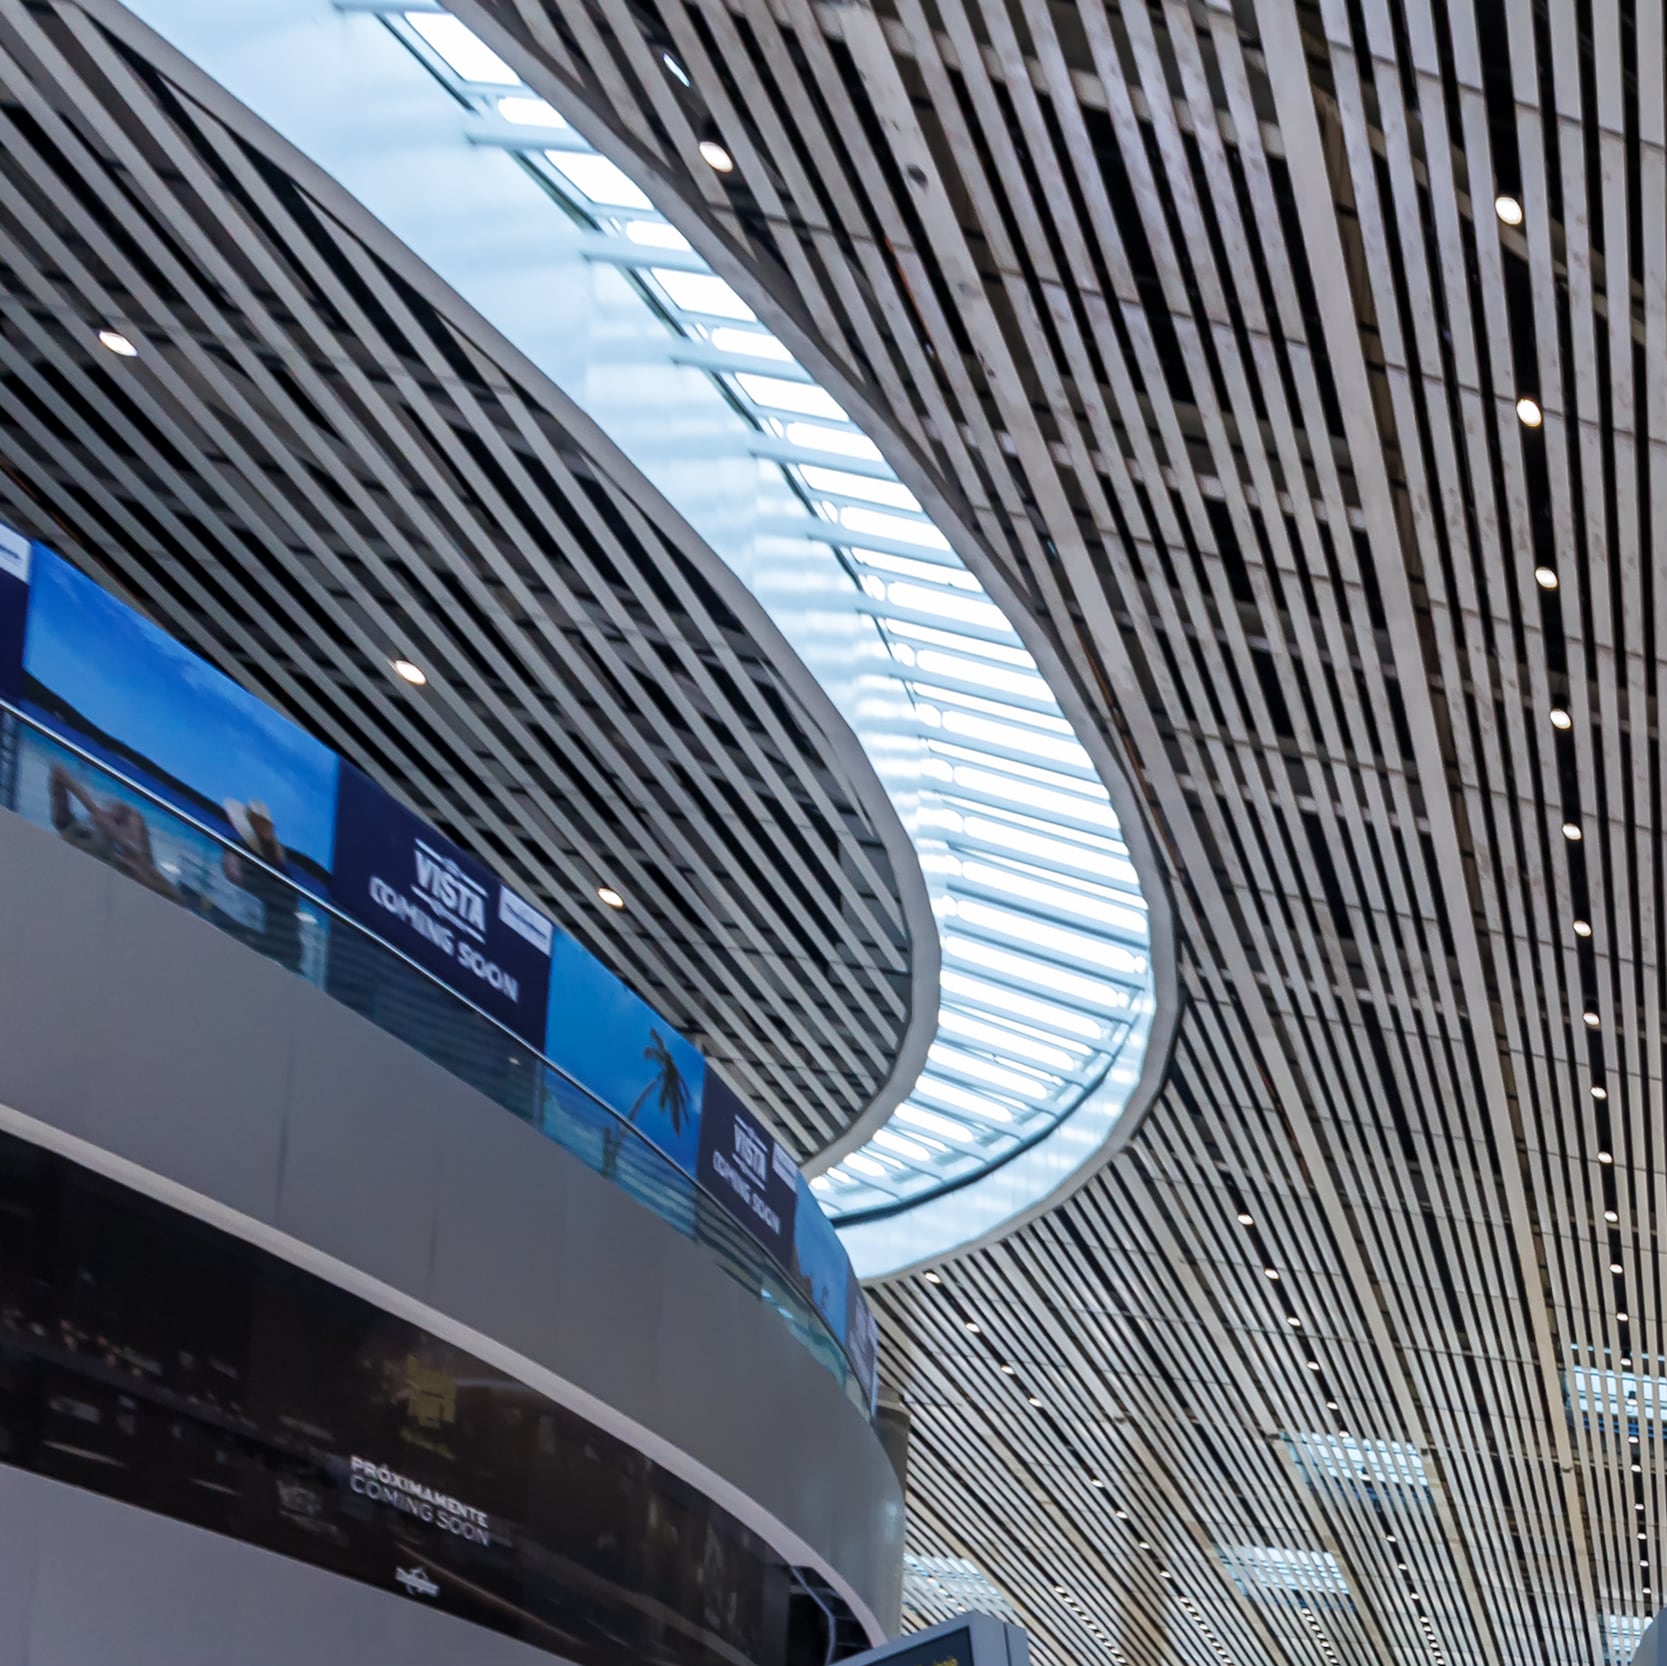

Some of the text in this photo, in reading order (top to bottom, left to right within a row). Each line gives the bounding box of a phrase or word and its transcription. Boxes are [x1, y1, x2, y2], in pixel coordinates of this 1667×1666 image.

[415, 850, 487, 933] VISTA
[369, 876, 455, 957] COMING
[456, 940, 519, 1003] SOON
[734, 1122, 767, 1184] VISTA
[351, 1455, 488, 1529] PRÓXIMAMENTE
[351, 1474, 489, 1548] COMING SOON
